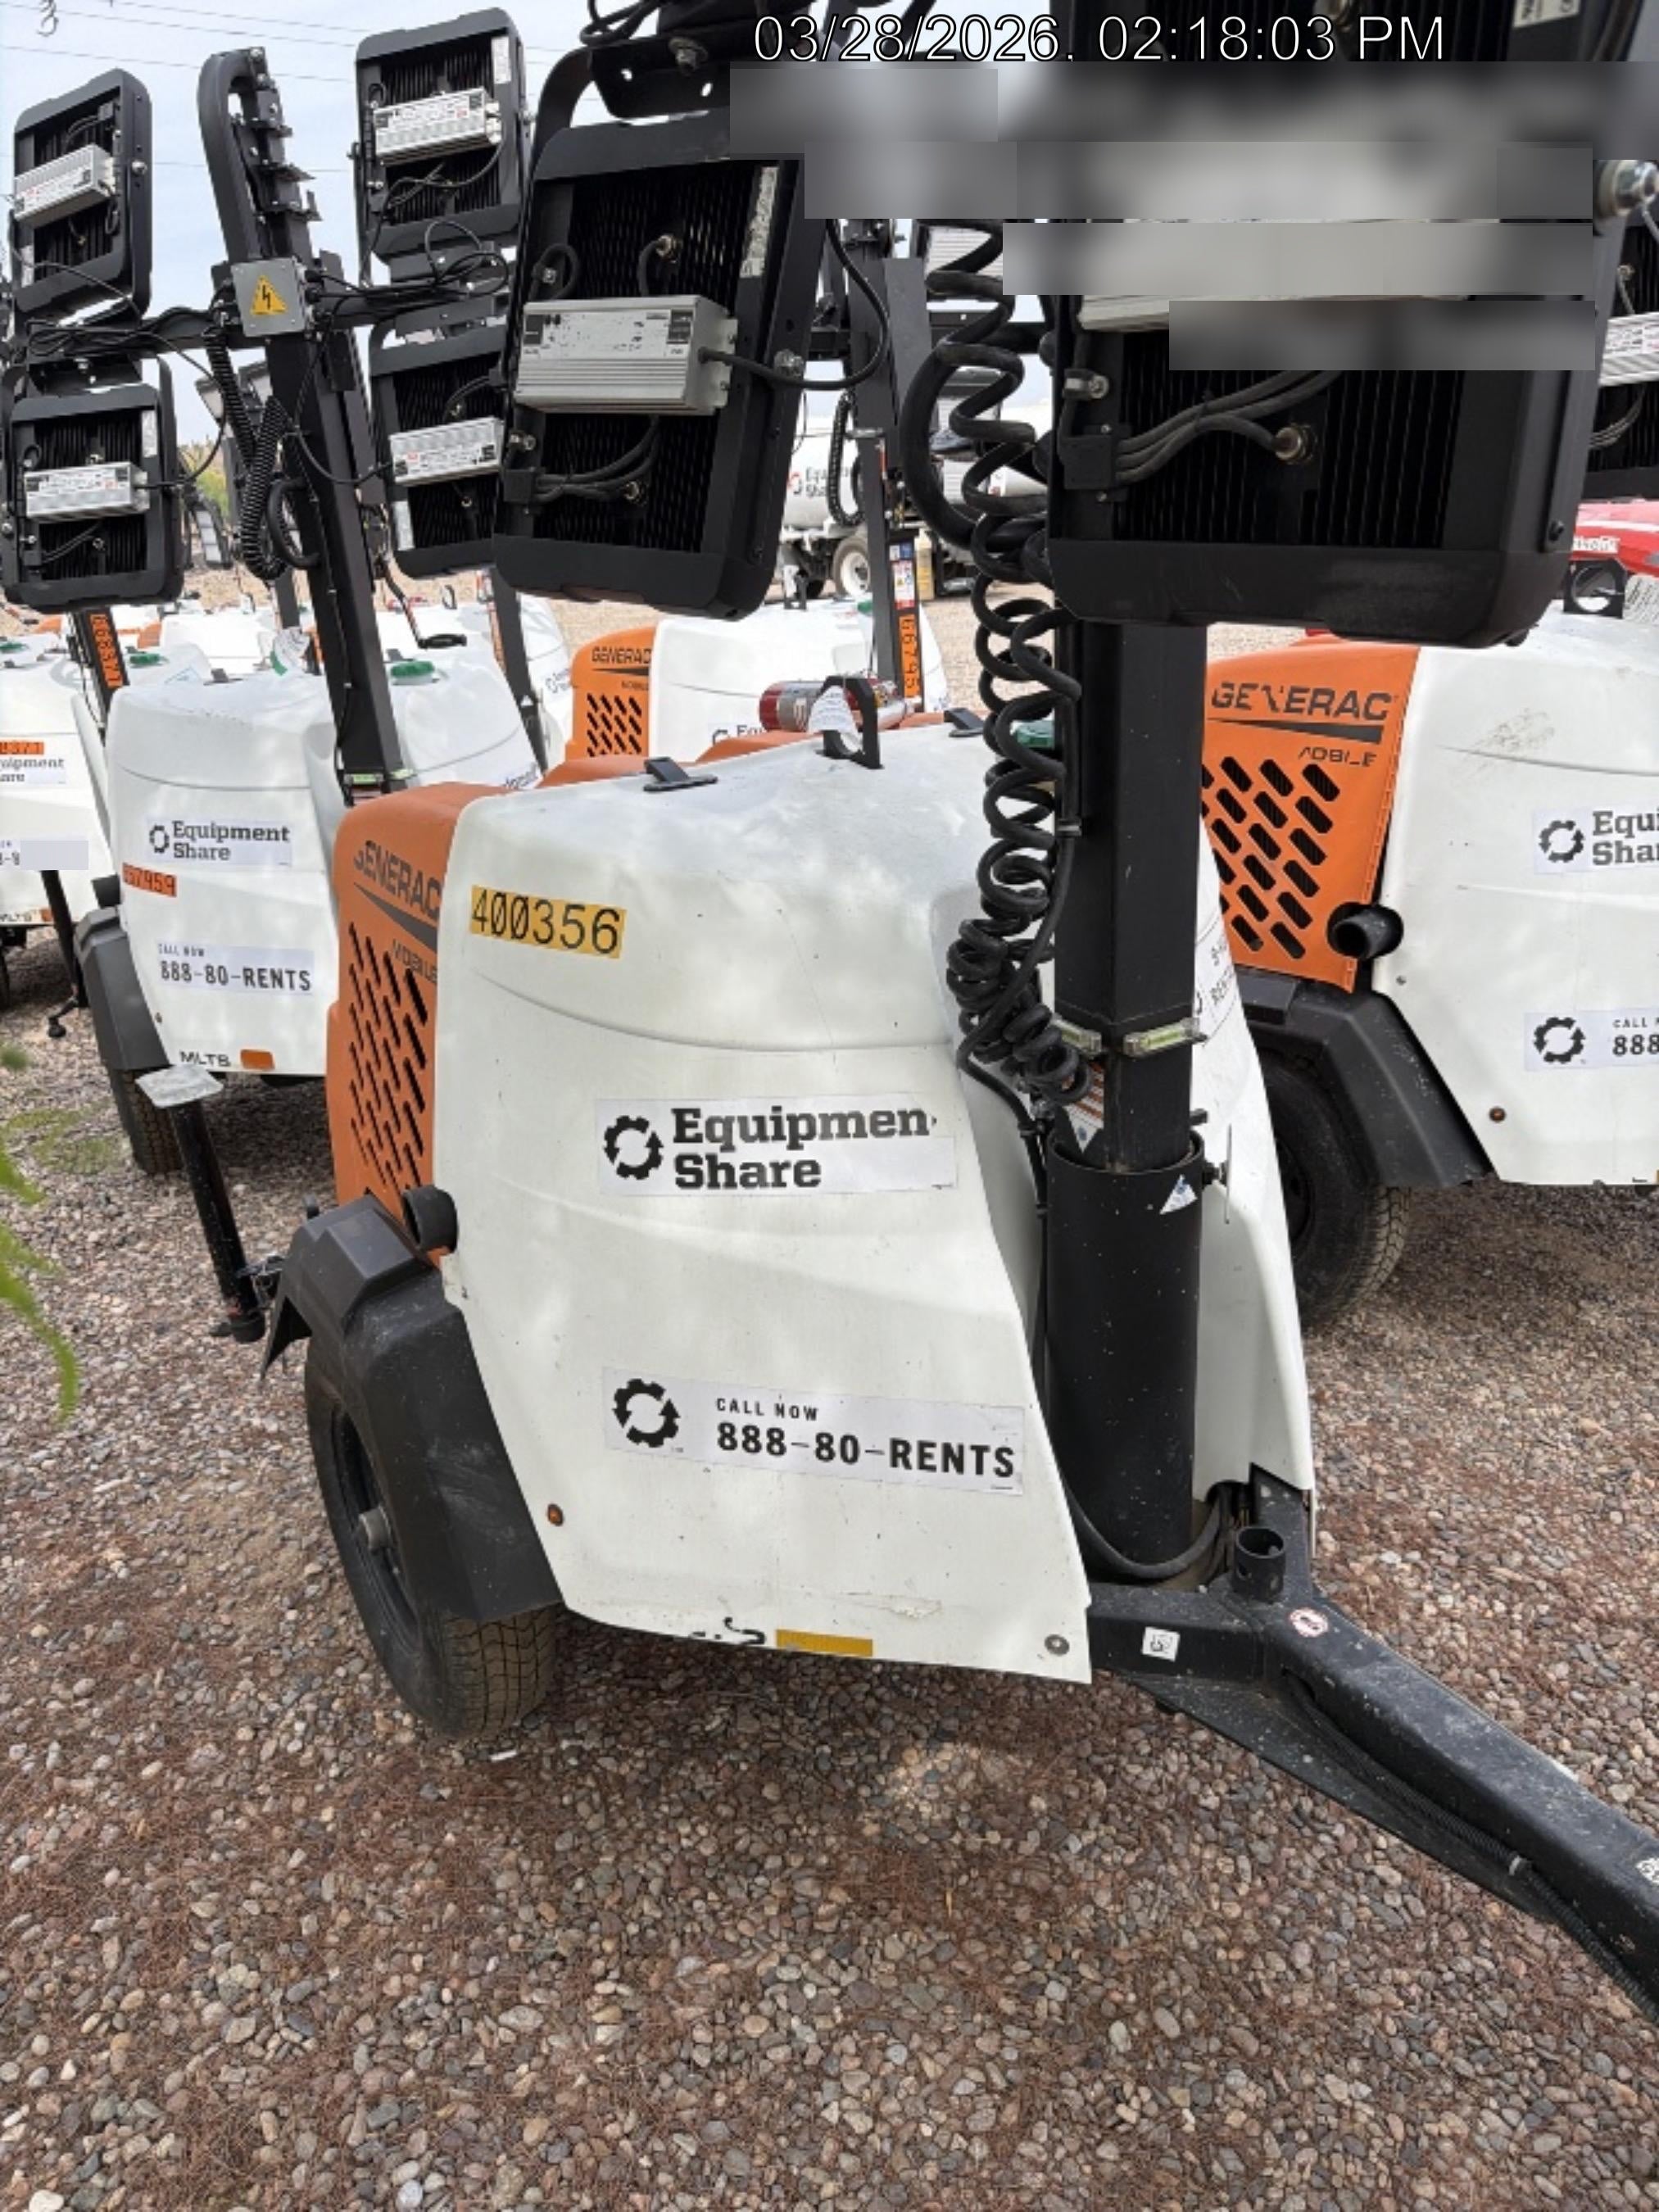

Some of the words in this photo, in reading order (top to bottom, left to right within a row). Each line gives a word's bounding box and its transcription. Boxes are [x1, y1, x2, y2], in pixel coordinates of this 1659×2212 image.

[171, 820, 290, 843] Equipment
[173, 842, 231, 860] Share
[471, 889, 620, 954] 400356
[161, 960, 311, 991] 888-80-RENTS
[1612, 1017, 1648, 1028] CALL
[670, 1105, 937, 1153] Equipmen
[673, 1152, 822, 1190] Share
[714, 1397, 765, 1417] CALL
[774, 1403, 819, 1422] NOW
[716, 1421, 1015, 1479] 888-80-RENTS
